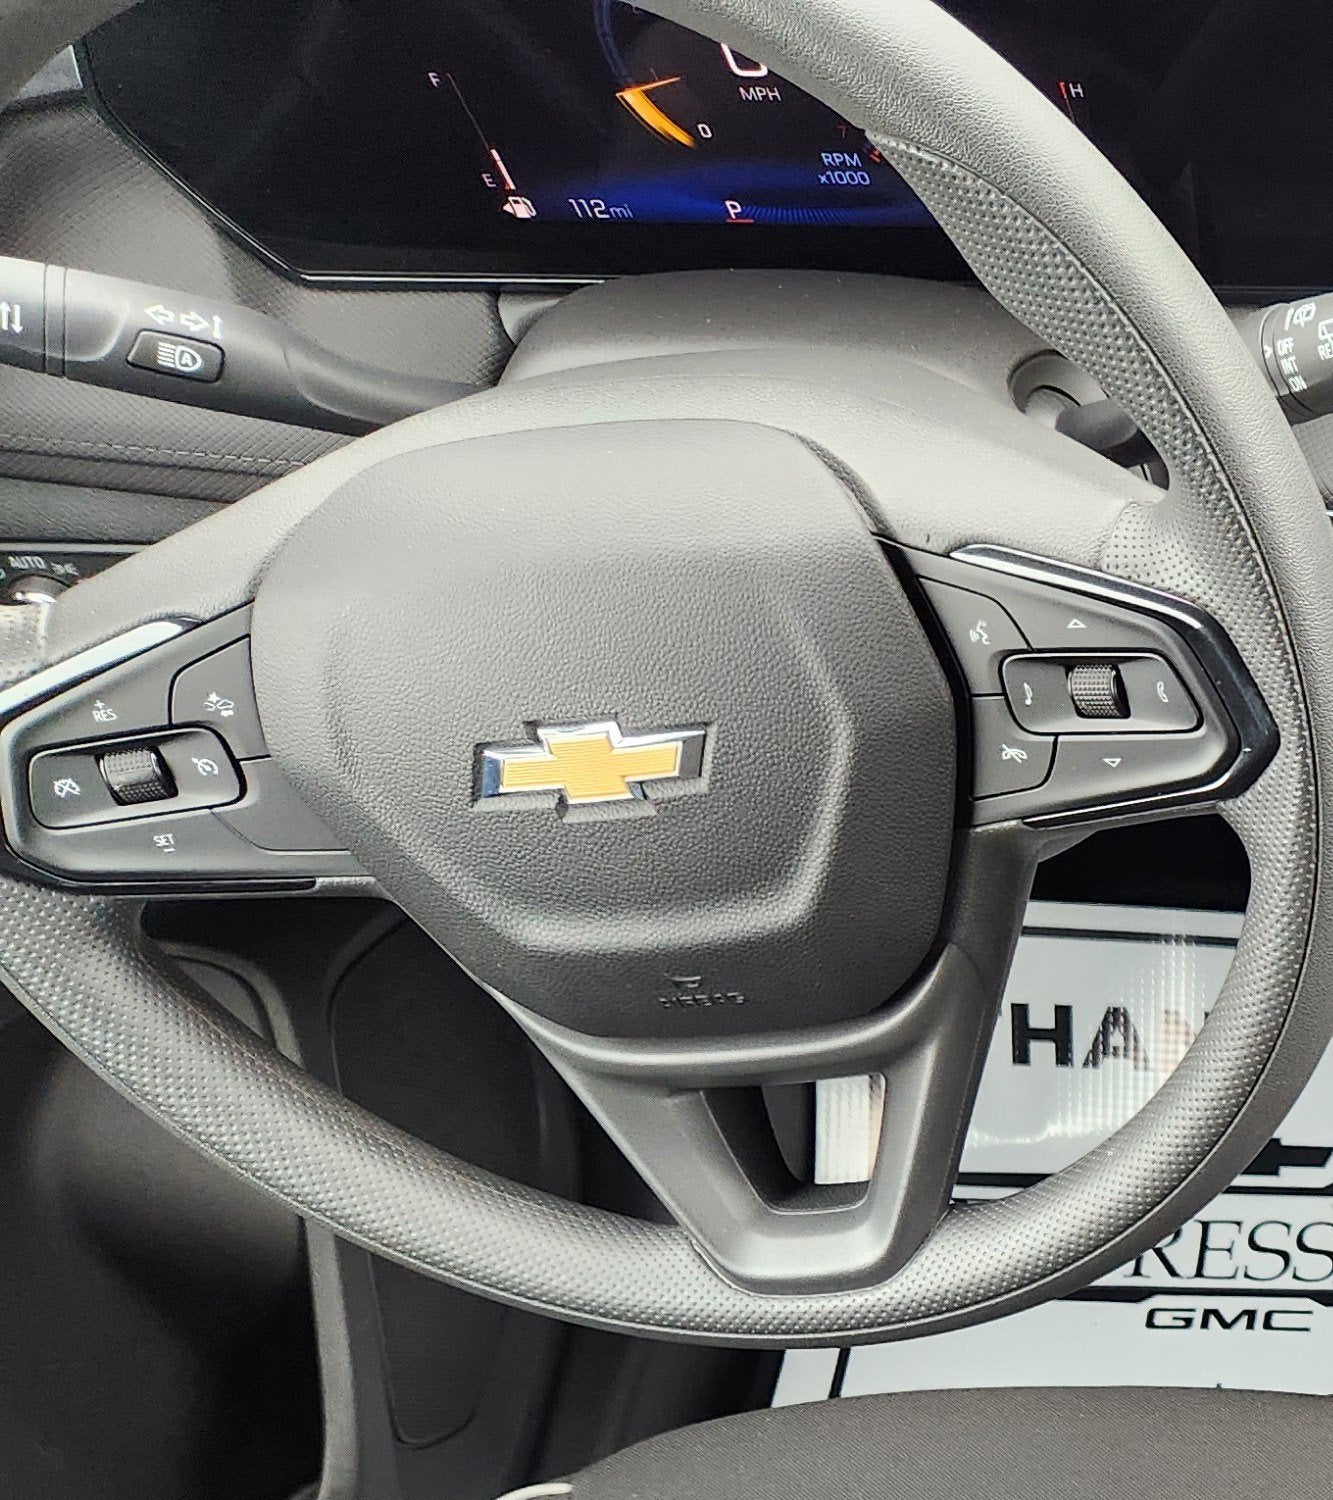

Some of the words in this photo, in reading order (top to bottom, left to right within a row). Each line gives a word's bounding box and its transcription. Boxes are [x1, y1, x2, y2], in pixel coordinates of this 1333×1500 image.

[429, 72, 441, 88] F
[738, 86, 782, 102] MPH
[1070, 82, 1083, 98] H
[820, 152, 863, 168] RPM
[482, 174, 496, 188] E
[818, 170, 871, 186] x1000
[724, 199, 742, 219] P
[1276, 337, 1294, 357] OFF
[1281, 355, 1299, 375] INT
[1288, 375, 1308, 392] ON
[8, 556, 46, 570] AUTO
[93, 707, 117, 723] RES
[153, 833, 174, 846] SET
[1143, 1306, 1316, 1332] GMC
